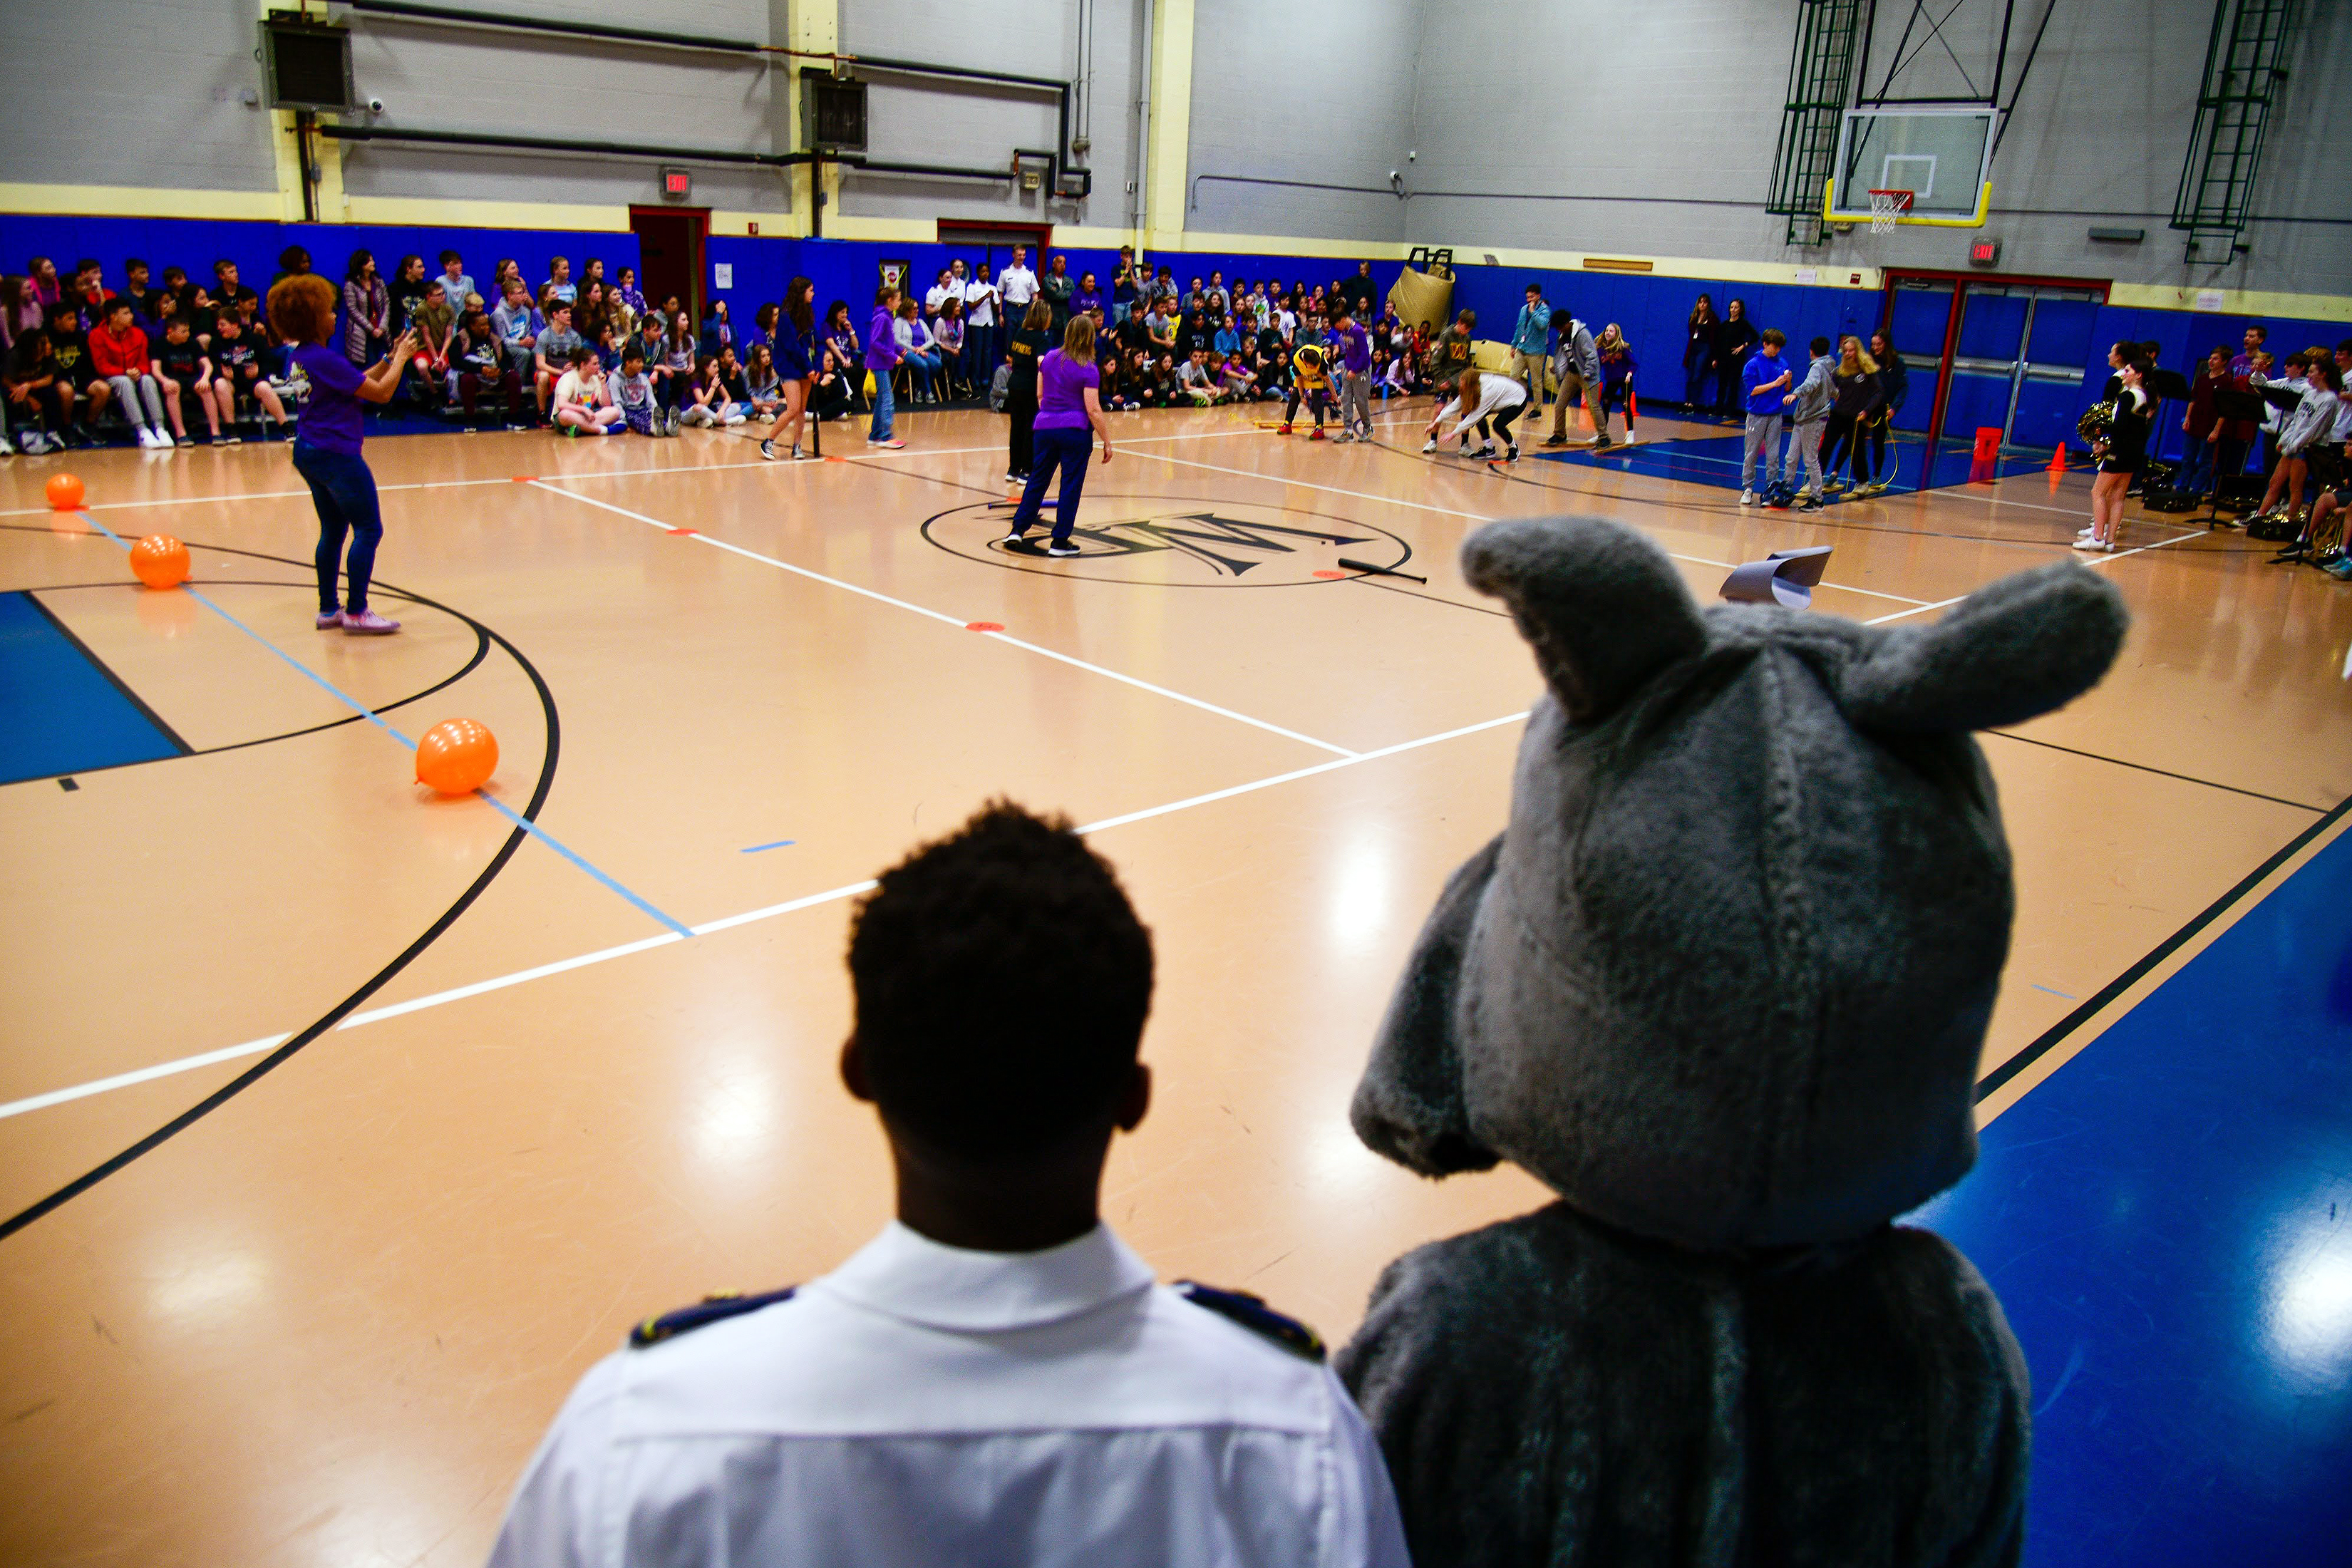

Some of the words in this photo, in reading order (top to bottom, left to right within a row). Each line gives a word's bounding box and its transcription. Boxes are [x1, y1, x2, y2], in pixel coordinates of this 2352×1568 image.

[667, 174, 687, 192] EXIT
[1973, 244, 1993, 259] EXIT
[1450, 341, 1469, 361] W
